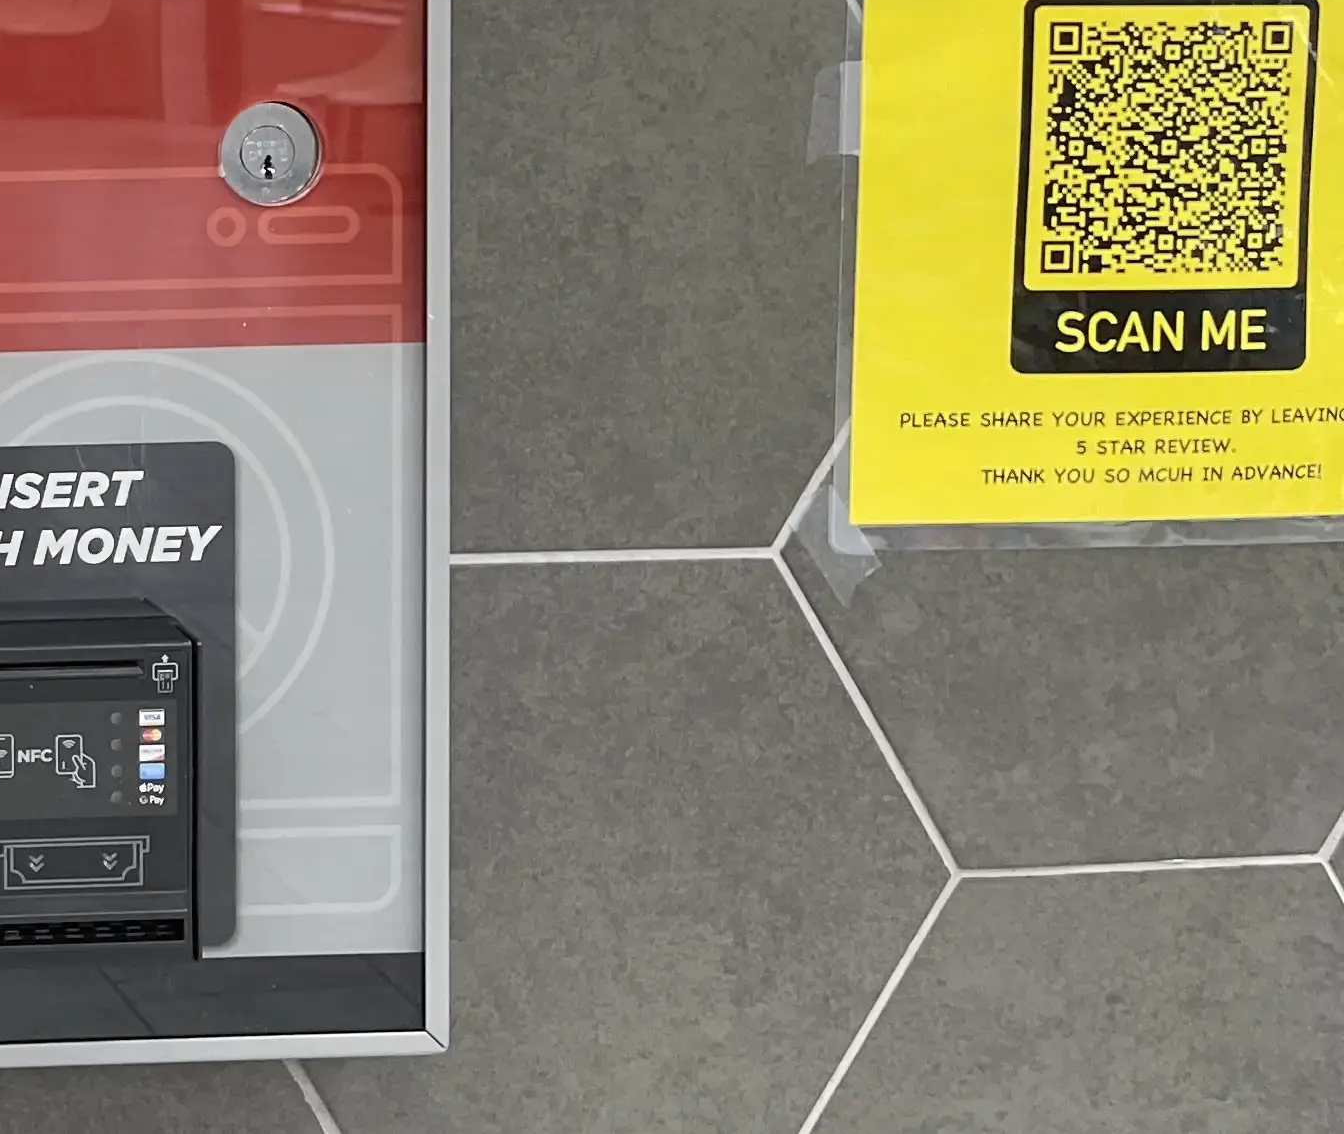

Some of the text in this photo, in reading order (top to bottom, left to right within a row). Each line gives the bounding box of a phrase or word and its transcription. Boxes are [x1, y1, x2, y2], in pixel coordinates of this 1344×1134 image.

[1054, 309, 1267, 352] SCAN ME
[899, 412, 971, 428] PLEASE
[980, 411, 1043, 428] SHARE
[1052, 411, 1106, 427] YOUR
[1115, 409, 1232, 426] EXPERIENCE
[1241, 409, 1263, 424] BY
[1076, 440, 1086, 455] 5
[1096, 440, 1145, 455] STAR
[982, 463, 1322, 485] THANK YOU SO MCUH IN ADVANCE!
[34, 524, 223, 566] MONEY
[17, 748, 53, 764] NFC
